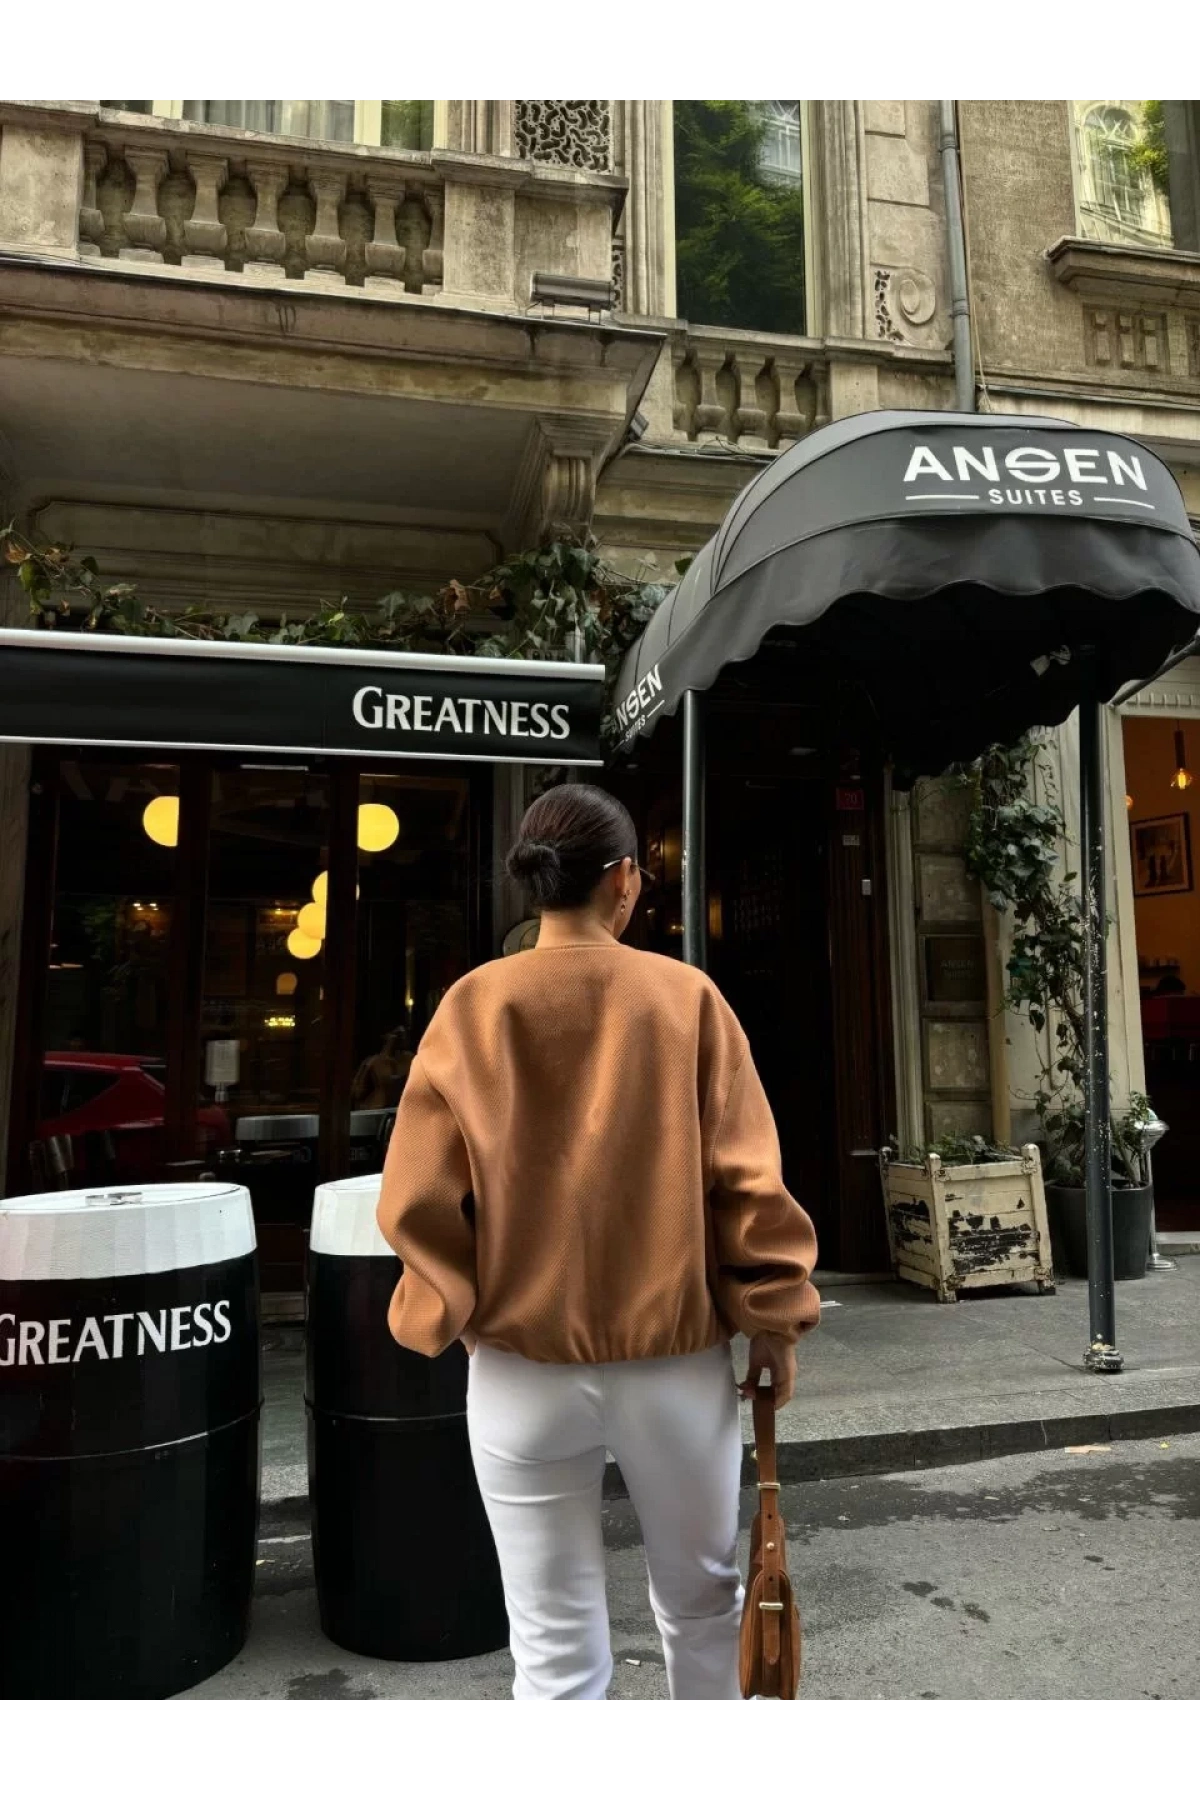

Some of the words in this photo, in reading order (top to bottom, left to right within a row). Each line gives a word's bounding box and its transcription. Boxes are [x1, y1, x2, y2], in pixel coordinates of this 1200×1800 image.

[903, 446, 1148, 491] ANSEN
[988, 488, 1083, 506] SUITES
[352, 685, 571, 740] GREATNESS
[613, 664, 662, 734] NSEN
